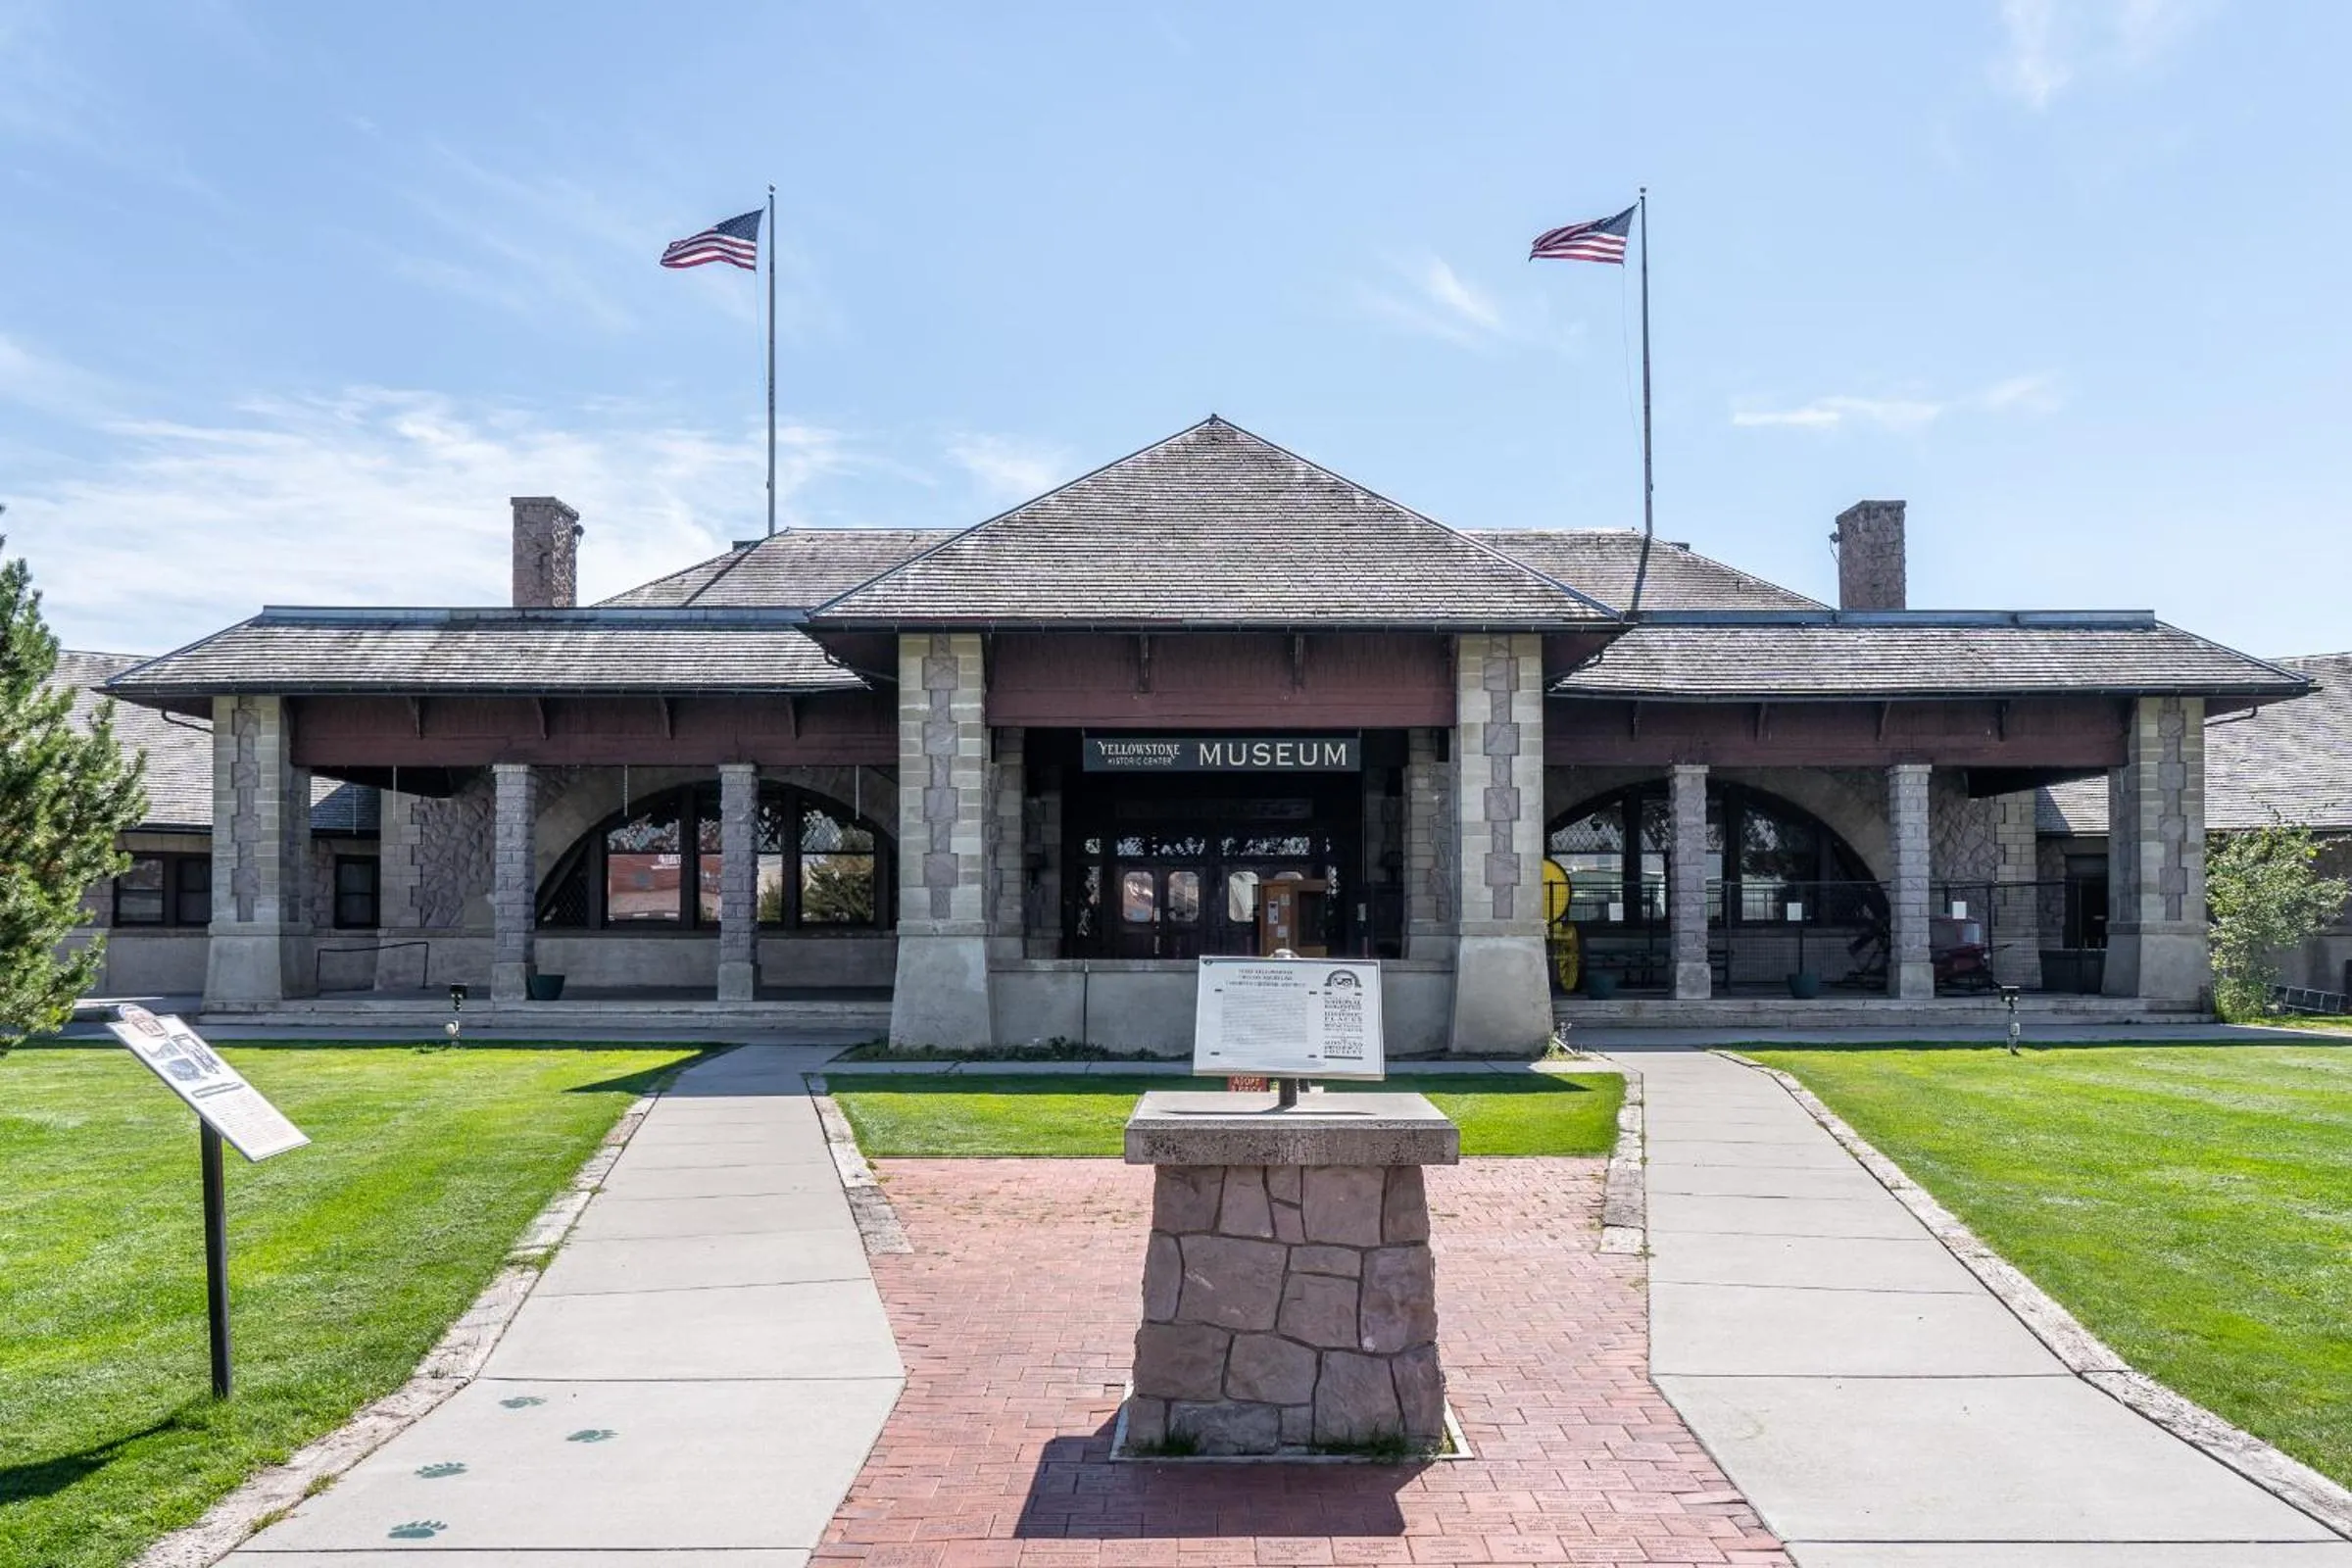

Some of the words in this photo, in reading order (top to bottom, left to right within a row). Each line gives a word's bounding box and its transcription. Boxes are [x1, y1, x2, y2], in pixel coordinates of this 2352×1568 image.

[1097, 741, 1181, 759] YELLOWSTONE
[1199, 742, 1347, 766] MUSEUM
[1107, 757, 1142, 766] HISTORIC
[1143, 757, 1173, 766] CENTER
